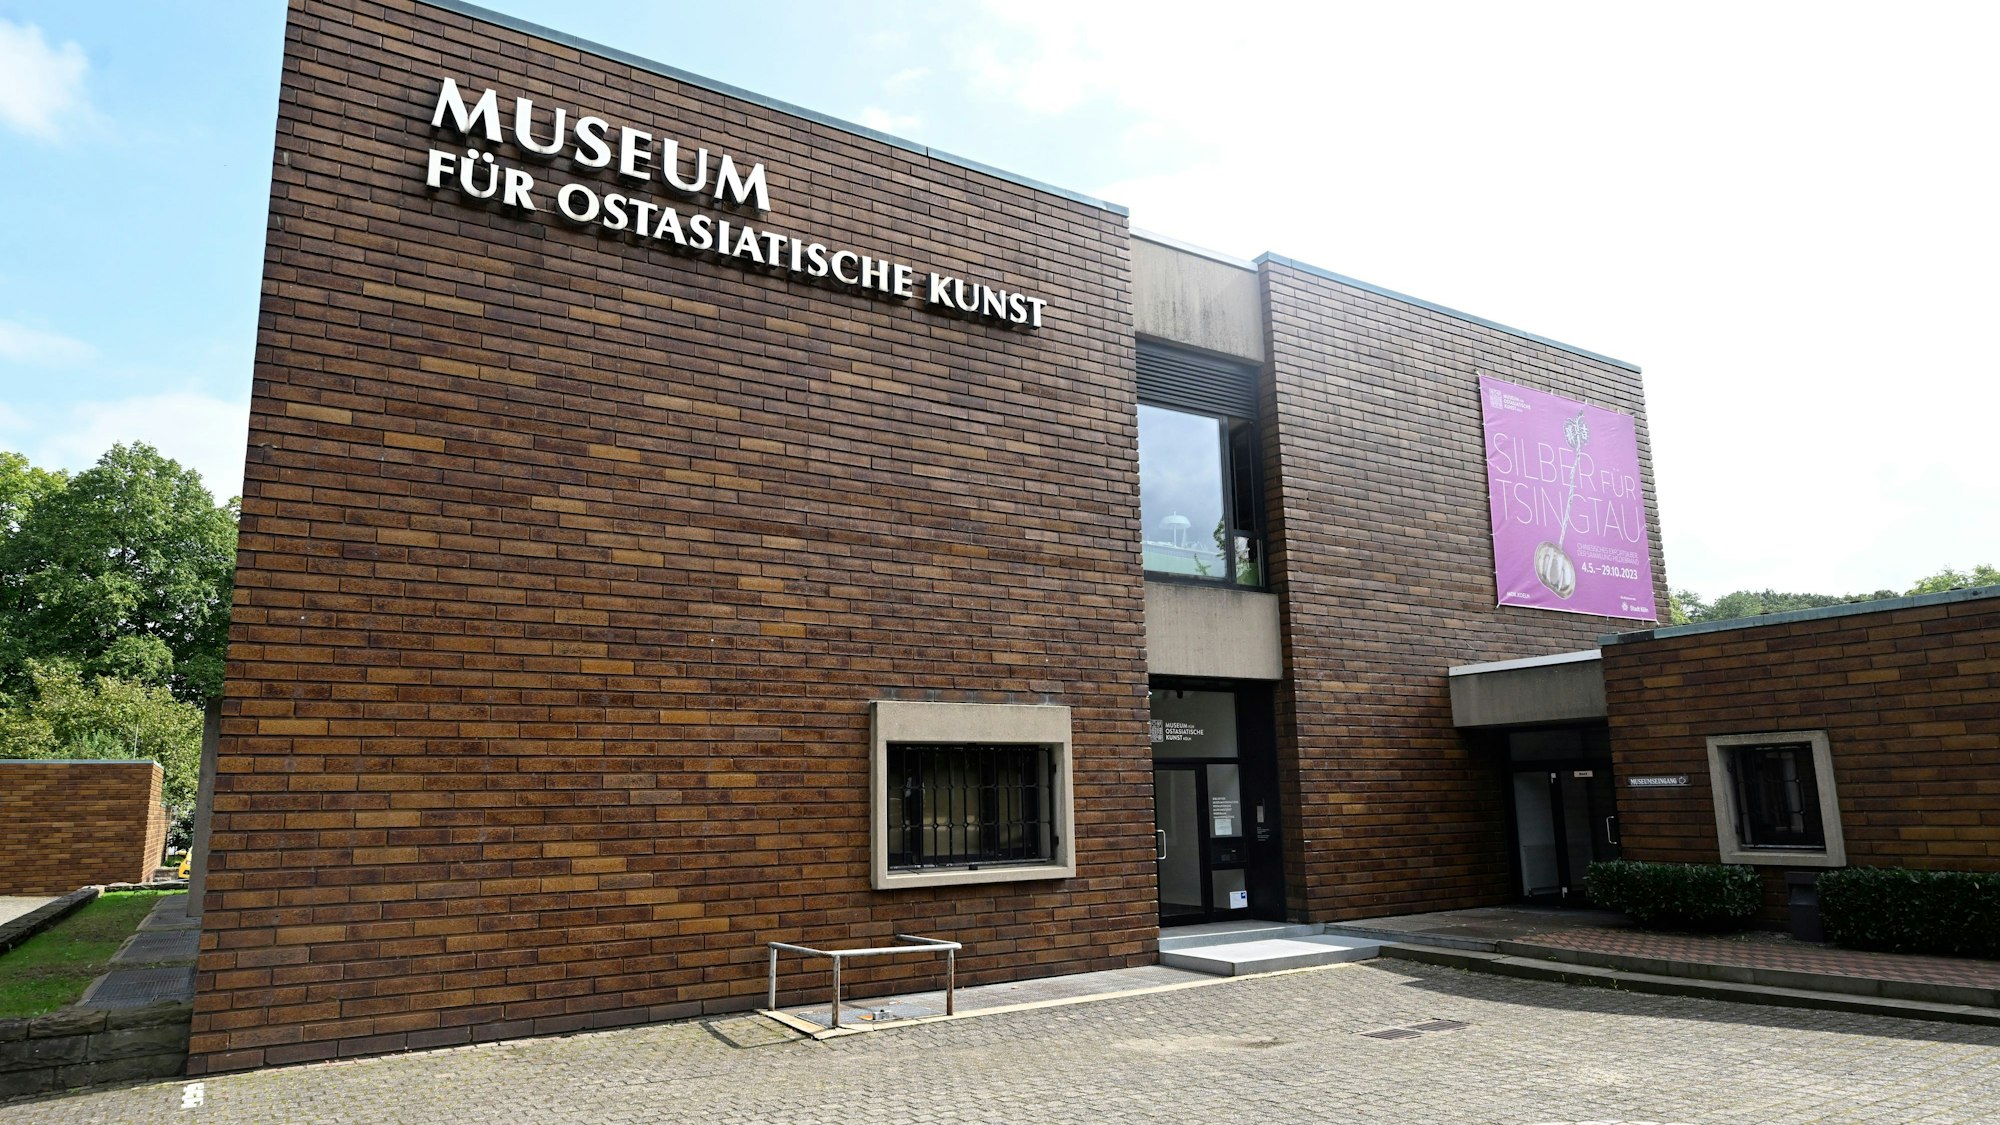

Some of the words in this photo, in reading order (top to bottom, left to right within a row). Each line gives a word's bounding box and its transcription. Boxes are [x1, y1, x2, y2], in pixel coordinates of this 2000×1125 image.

[430, 77, 772, 213] MUSEUM
[426, 149, 537, 212] FÜR
[557, 183, 914, 299] OSTASIATISCHE
[929, 272, 1048, 329] KUNST
[1493, 432, 1596, 491] SILBER
[1600, 467, 1636, 500] FÜR
[1495, 478, 1640, 543] TSINGTAU
[1165, 728, 1204, 736] OSTASIATISCHE
